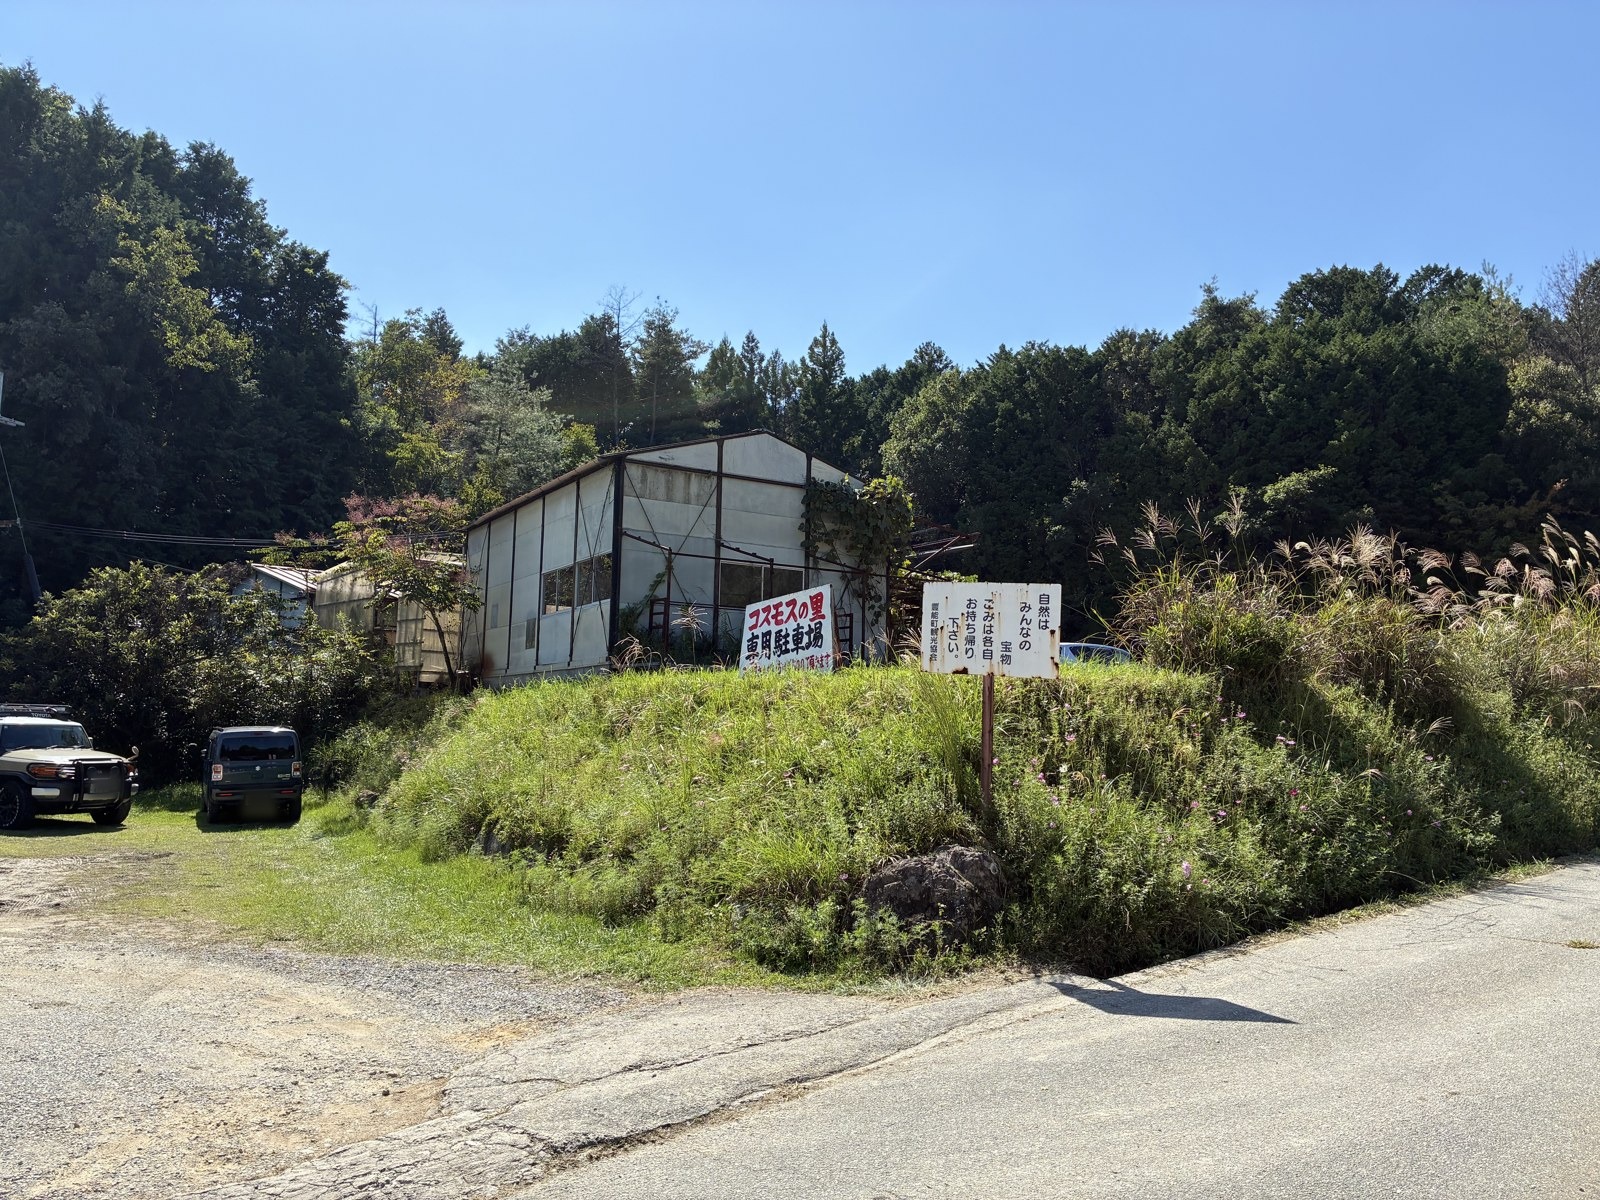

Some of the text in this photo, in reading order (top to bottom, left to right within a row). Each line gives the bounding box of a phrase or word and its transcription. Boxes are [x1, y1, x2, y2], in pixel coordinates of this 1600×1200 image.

[748, 591, 826, 632] コスモスの里
[964, 598, 977, 659] お持ち帰り
[982, 599, 995, 660] ごみは各自
[1019, 602, 1032, 651] みんなの
[1038, 593, 1050, 631] 自然は
[745, 621, 824, 663] 専用駐車場
[948, 617, 960, 659] 下さい。
[1000, 641, 1012, 666] 宝物
